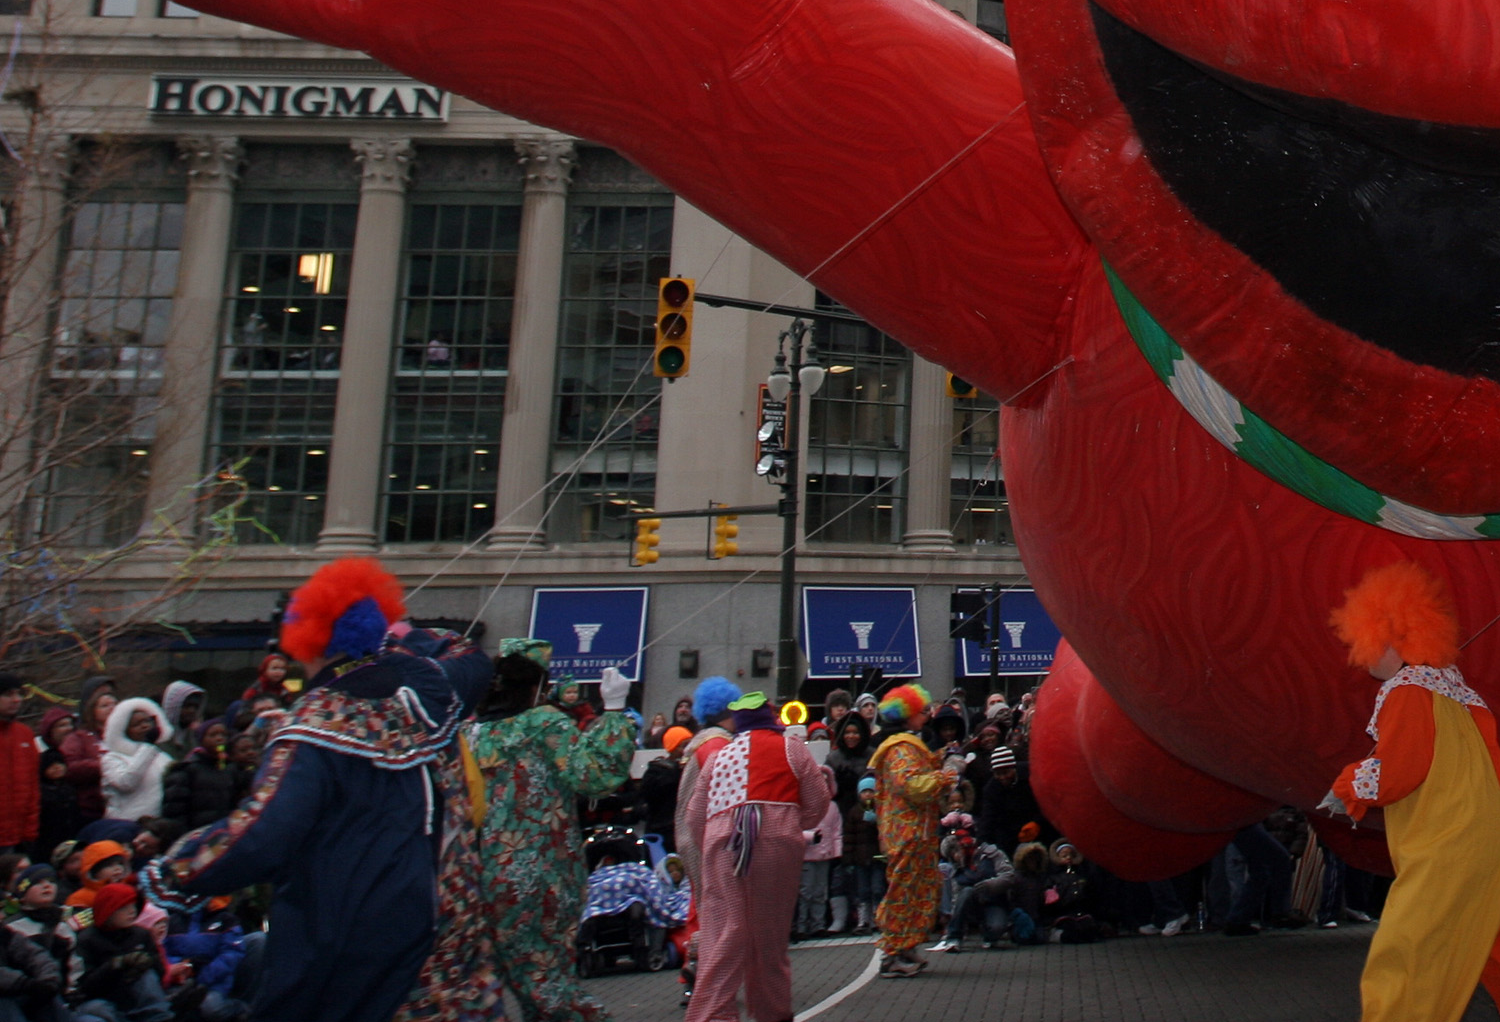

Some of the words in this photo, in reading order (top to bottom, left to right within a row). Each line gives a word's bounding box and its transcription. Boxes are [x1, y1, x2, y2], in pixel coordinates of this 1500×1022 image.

[151, 78, 444, 116] HONIGMAN
[549, 660, 570, 668] RST
[824, 656, 852, 664] FIRST
[855, 656, 904, 664] NATIONAL
